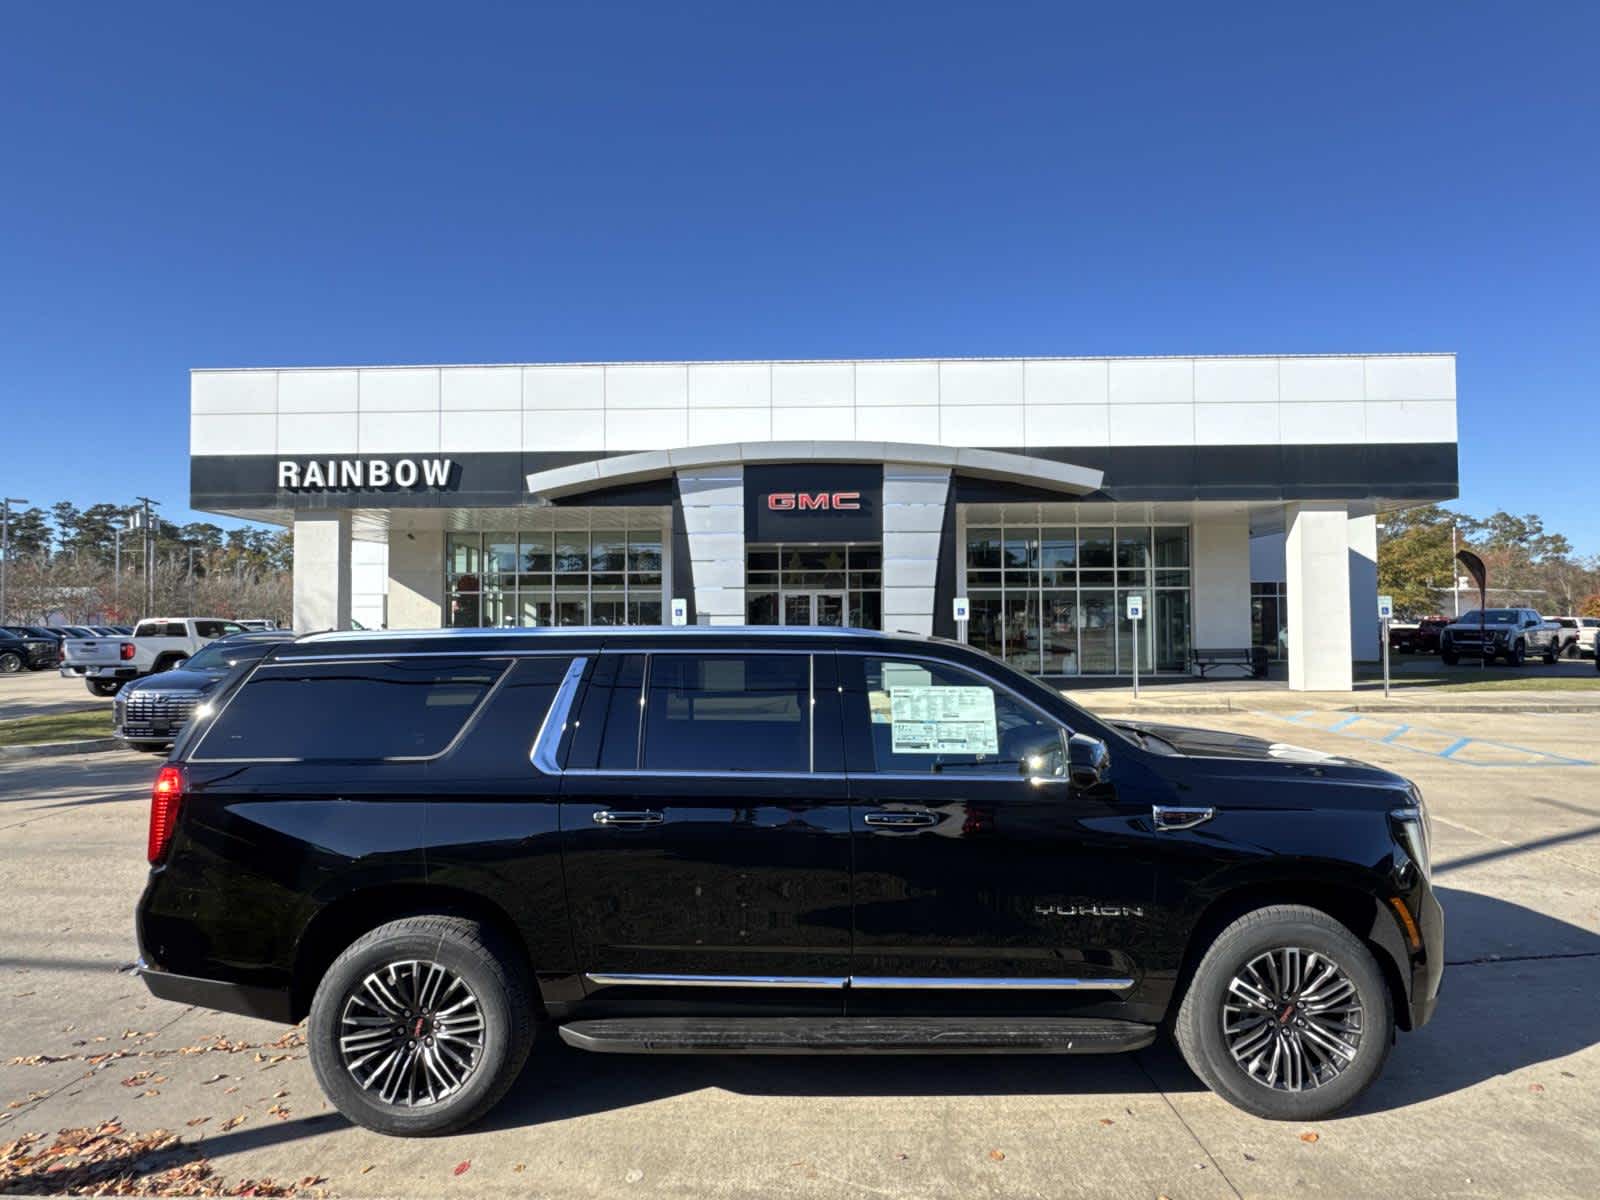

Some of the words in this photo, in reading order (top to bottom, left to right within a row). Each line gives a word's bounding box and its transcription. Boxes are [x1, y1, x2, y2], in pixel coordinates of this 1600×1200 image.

[277, 459, 451, 488] RAINBOW
[767, 492, 860, 511] GMC
[1034, 904, 1144, 917] YUKON
